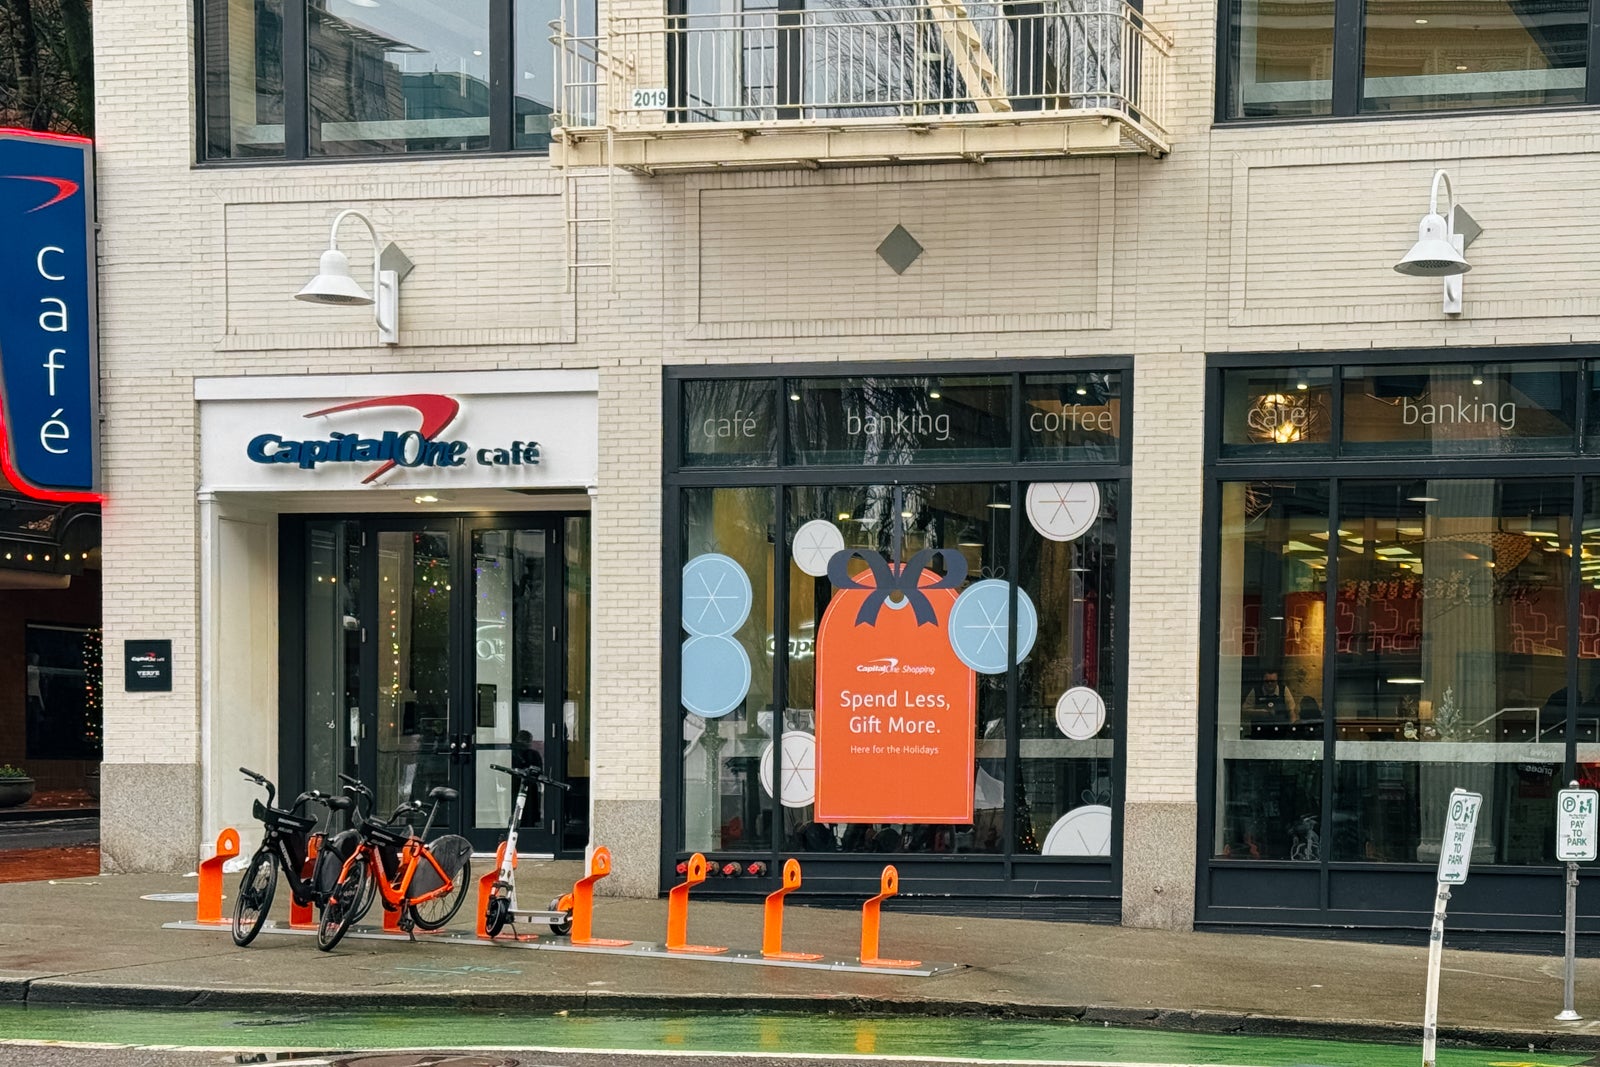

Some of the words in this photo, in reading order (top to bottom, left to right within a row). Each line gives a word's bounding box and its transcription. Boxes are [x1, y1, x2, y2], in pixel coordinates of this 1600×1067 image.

[634, 91, 666, 107] 2019
[37, 246, 70, 455] café
[1029, 404, 1113, 433] coffee
[1403, 395, 1516, 431] banking
[703, 410, 756, 438] café
[847, 407, 950, 441] banking
[477, 441, 541, 466] café
[902, 665, 936, 676] Shopping
[840, 690, 897, 711] Spend
[905, 690, 951, 711] Less,
[850, 715, 881, 734] Gift
[888, 717, 941, 734] More.
[850, 745, 870, 754] Here
[872, 744, 885, 754] for
[887, 744, 901, 754] the
[903, 744, 939, 755] Holidays
[1570, 820, 1585, 828] PAY
[1453, 831, 1466, 842] PAY
[1572, 829, 1583, 837] TO
[1453, 843, 1462, 854] TO
[1567, 838, 1587, 846] PARK
[1447, 854, 1464, 865] PARK
